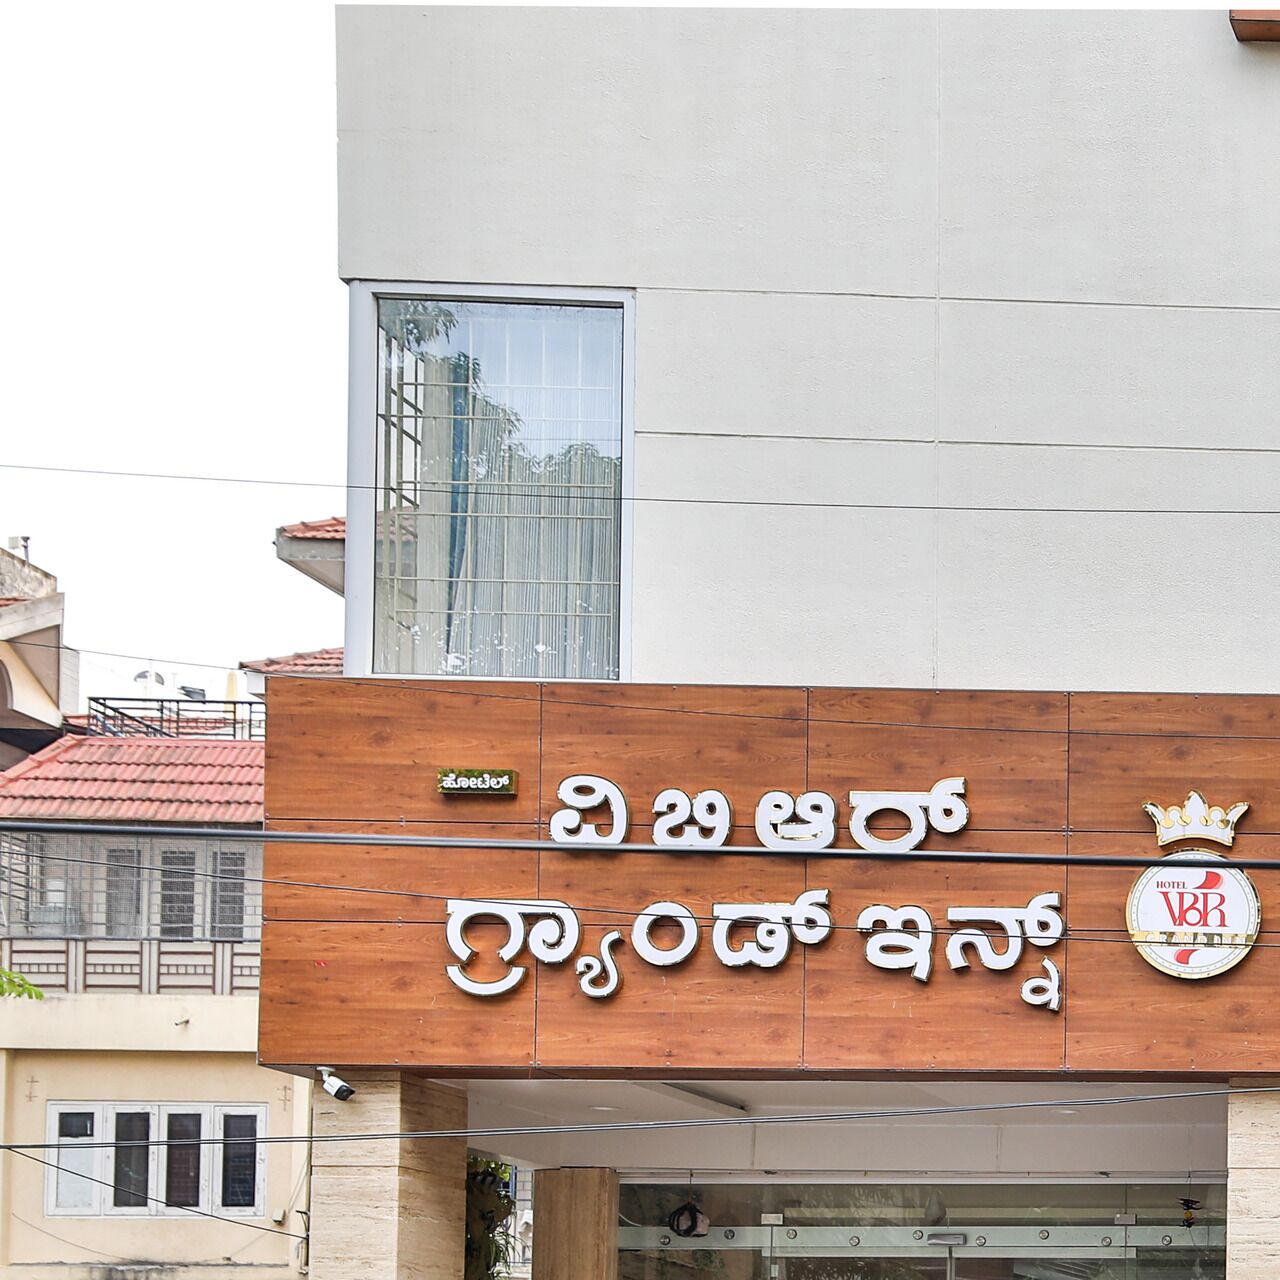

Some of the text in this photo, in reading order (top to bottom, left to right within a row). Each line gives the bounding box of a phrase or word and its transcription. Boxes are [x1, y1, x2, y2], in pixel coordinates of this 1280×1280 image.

[442, 773, 509, 788] ಹೋಟೆಲ್
[1156, 881, 1188, 890] HOTEL
[1158, 891, 1231, 928] VBR
